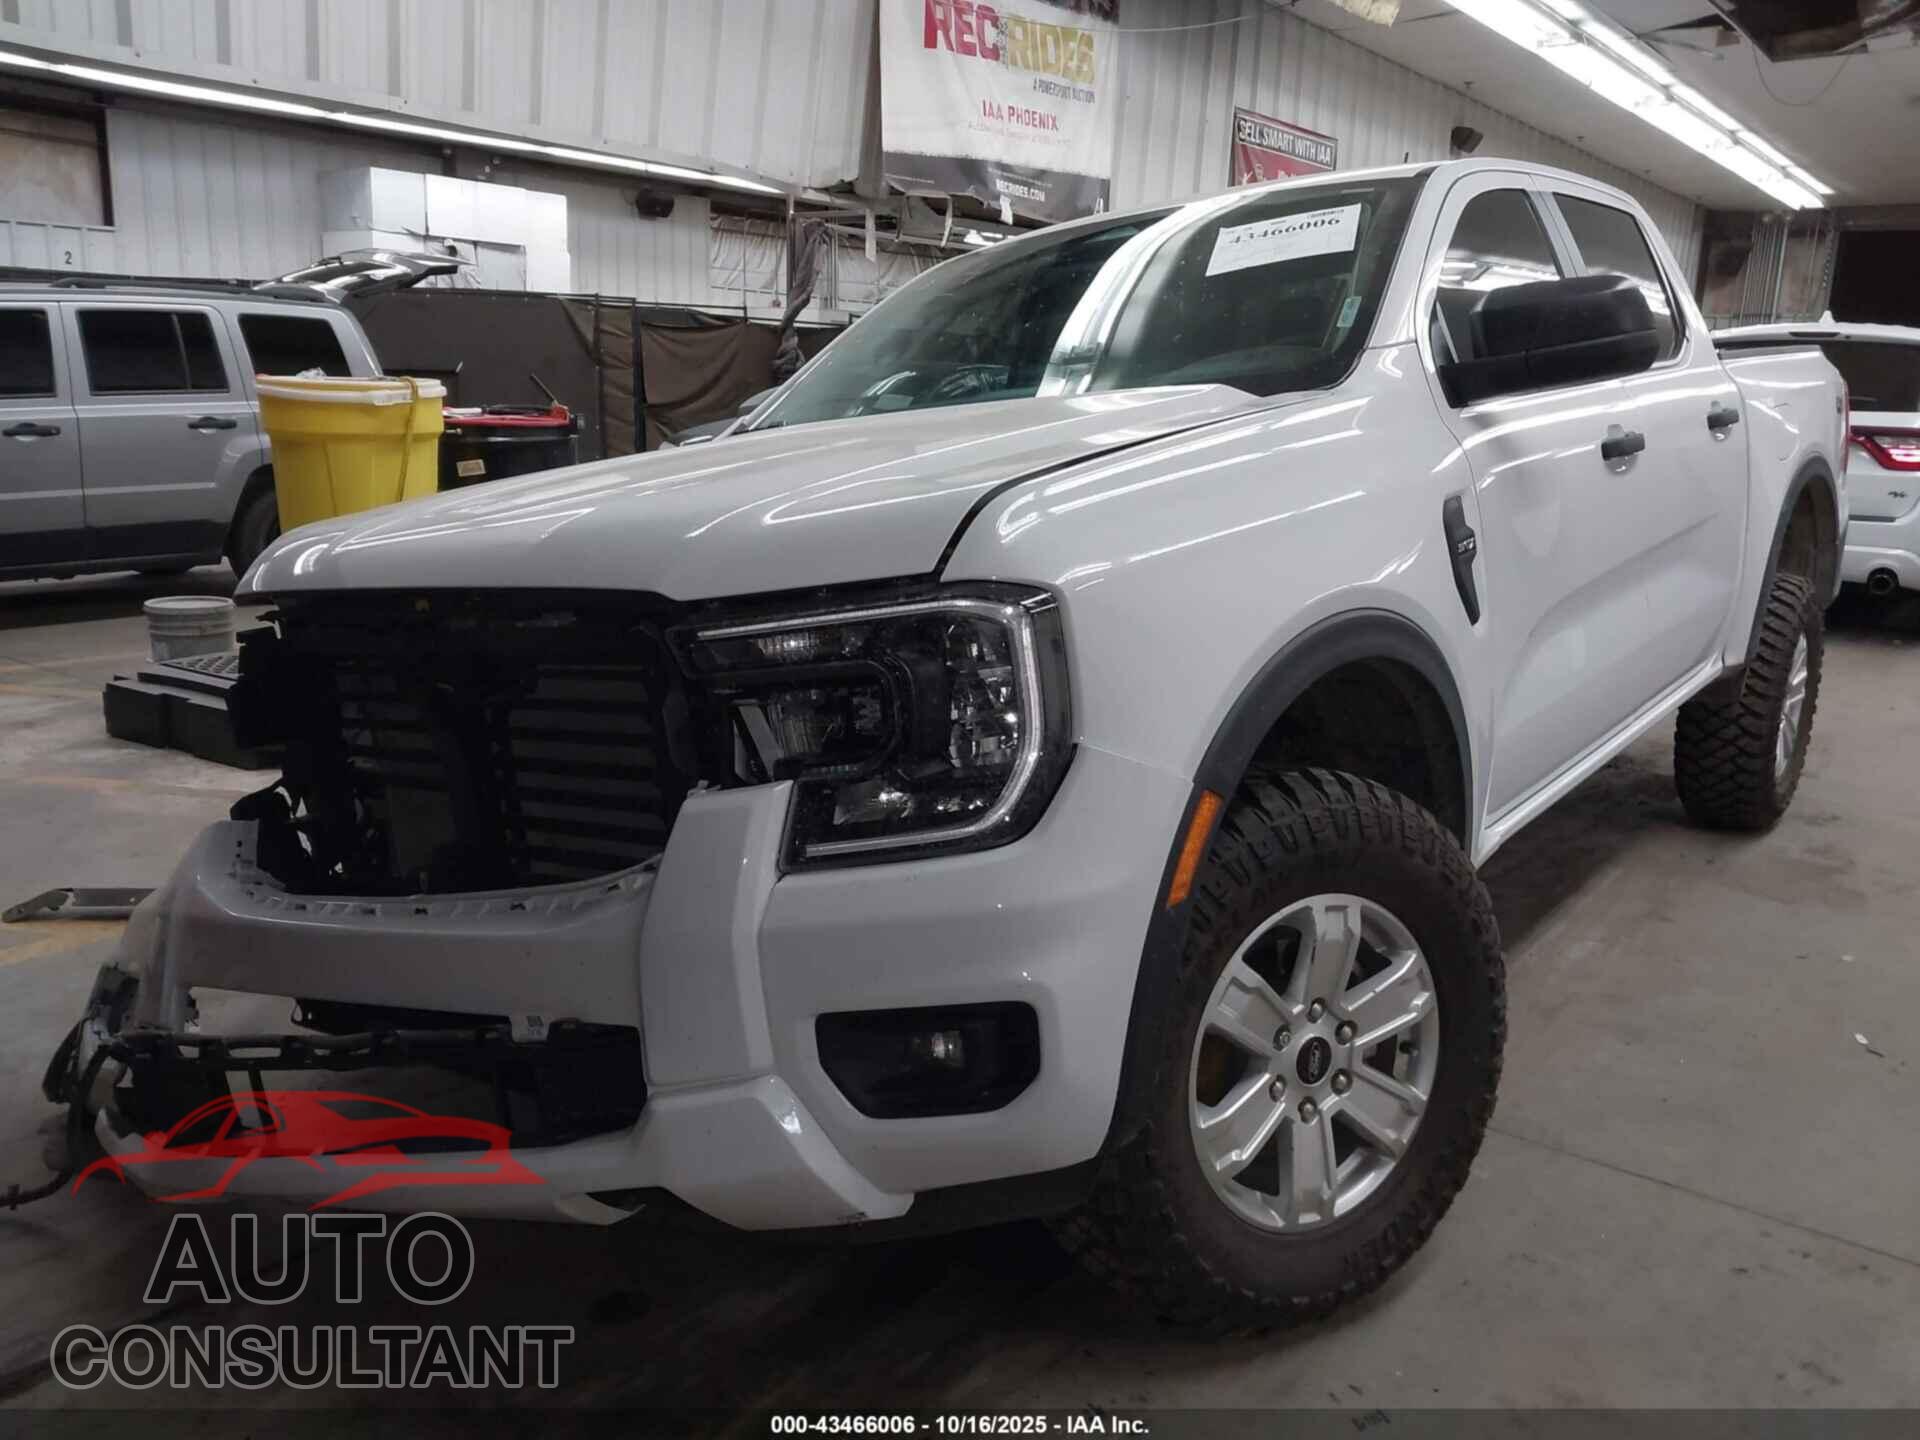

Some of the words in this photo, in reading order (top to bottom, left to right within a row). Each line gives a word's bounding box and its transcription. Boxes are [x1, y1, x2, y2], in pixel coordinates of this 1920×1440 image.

[923, 0, 1000, 61] REC
[1007, 14, 1095, 84] RIDES
[982, 99, 1004, 120] IAA
[1007, 105, 1059, 131] PHOENIX
[1239, 119, 1261, 144] SELL
[1262, 126, 1294, 153] SMART
[1295, 136, 1316, 161] WITH
[1317, 144, 1332, 165] IAA
[995, 178, 1046, 202] RECRIDES.COM
[64, 250, 72, 265] 2
